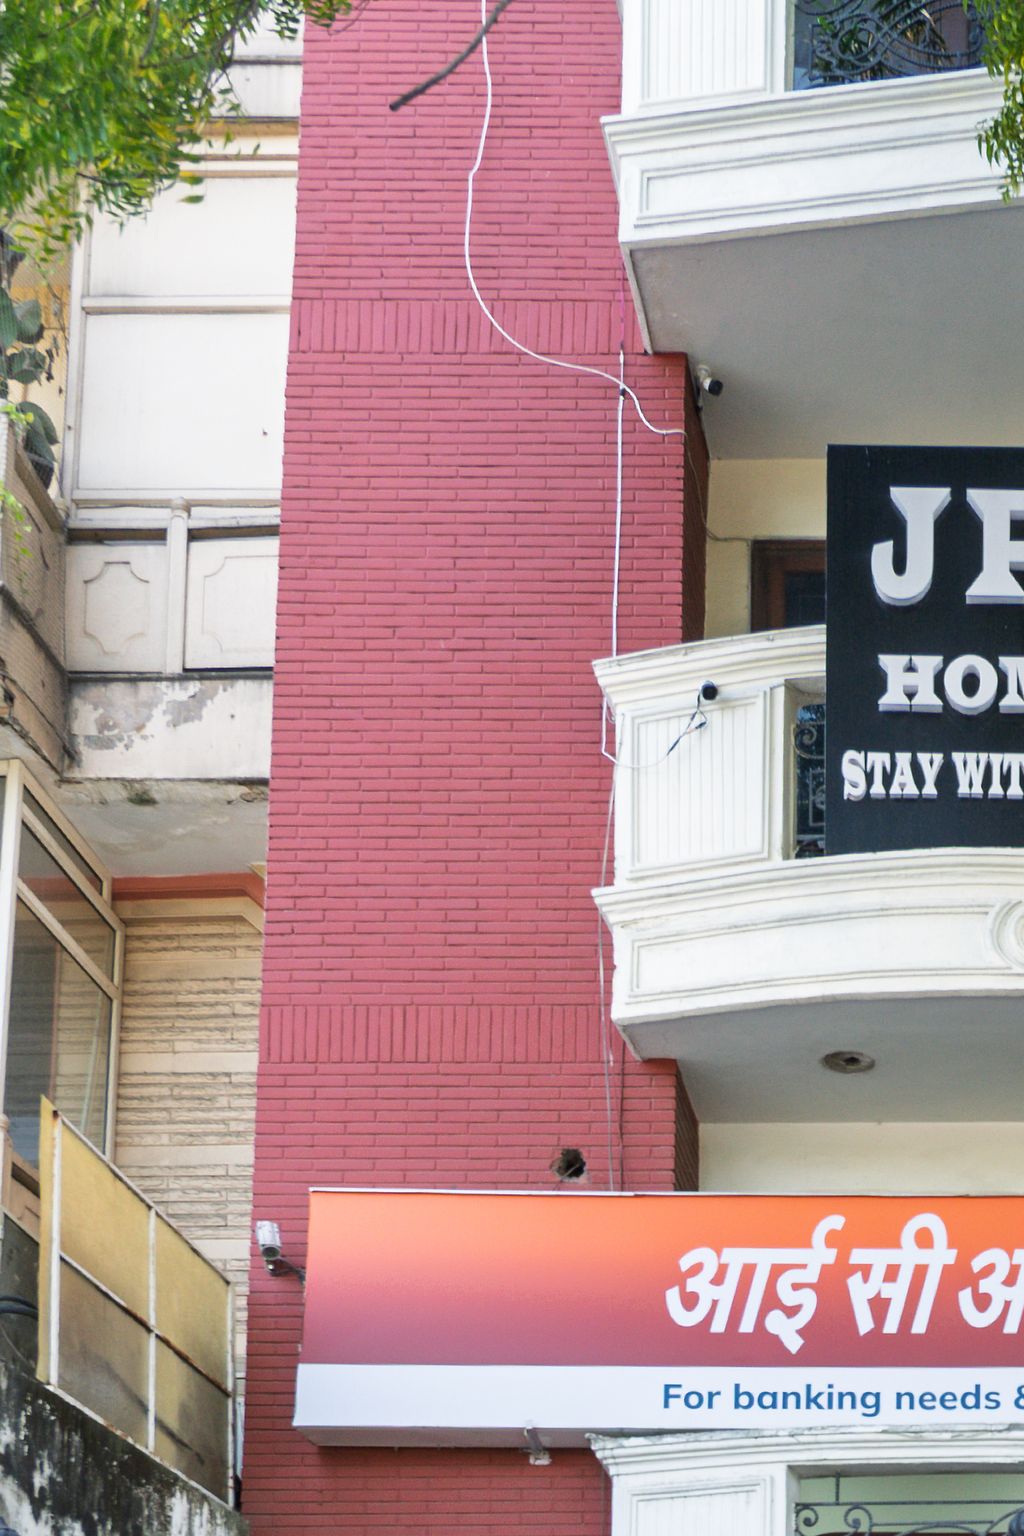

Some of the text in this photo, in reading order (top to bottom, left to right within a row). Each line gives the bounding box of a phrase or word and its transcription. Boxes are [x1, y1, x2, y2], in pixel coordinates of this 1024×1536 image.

[841, 749, 943, 801] STAY
[665, 1214, 846, 1355] आई
[848, 1212, 957, 1335] सी
[662, 1384, 721, 1409] For
[733, 1383, 881, 1416] banking
[895, 1384, 1001, 1410] needs
